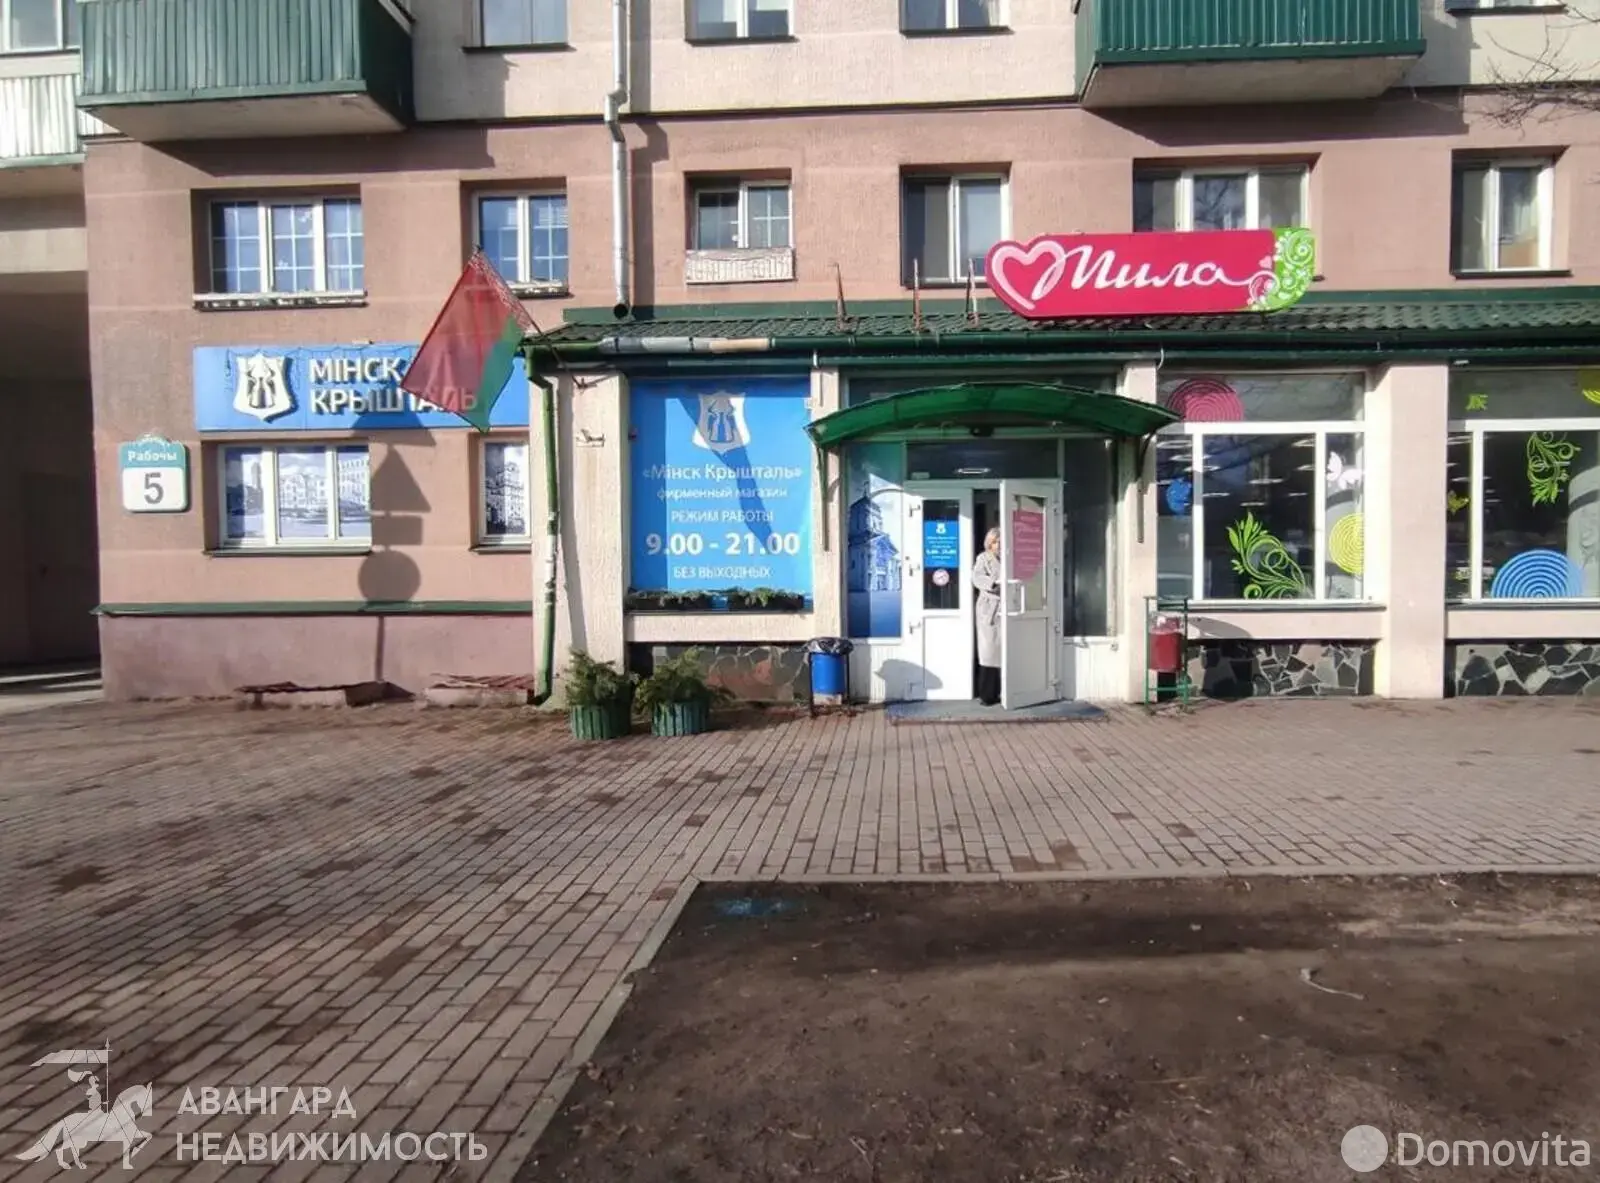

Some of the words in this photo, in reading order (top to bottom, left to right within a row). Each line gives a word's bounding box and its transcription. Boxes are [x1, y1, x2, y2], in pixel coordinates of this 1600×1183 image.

[1032, 244, 1251, 300] Мила
[308, 356, 403, 383] МІНСК
[143, 471, 165, 505] 5
[657, 487, 733, 500] фирменный
[734, 488, 789, 499] магазин
[671, 510, 719, 522] РЕЖИМ
[721, 510, 774, 522] РАБОТЫ
[645, 532, 703, 556] 9.00
[724, 532, 800, 556] 21.00
[673, 566, 697, 579] БЕЗ
[699, 566, 772, 580] ВЫХОДНЫХ
